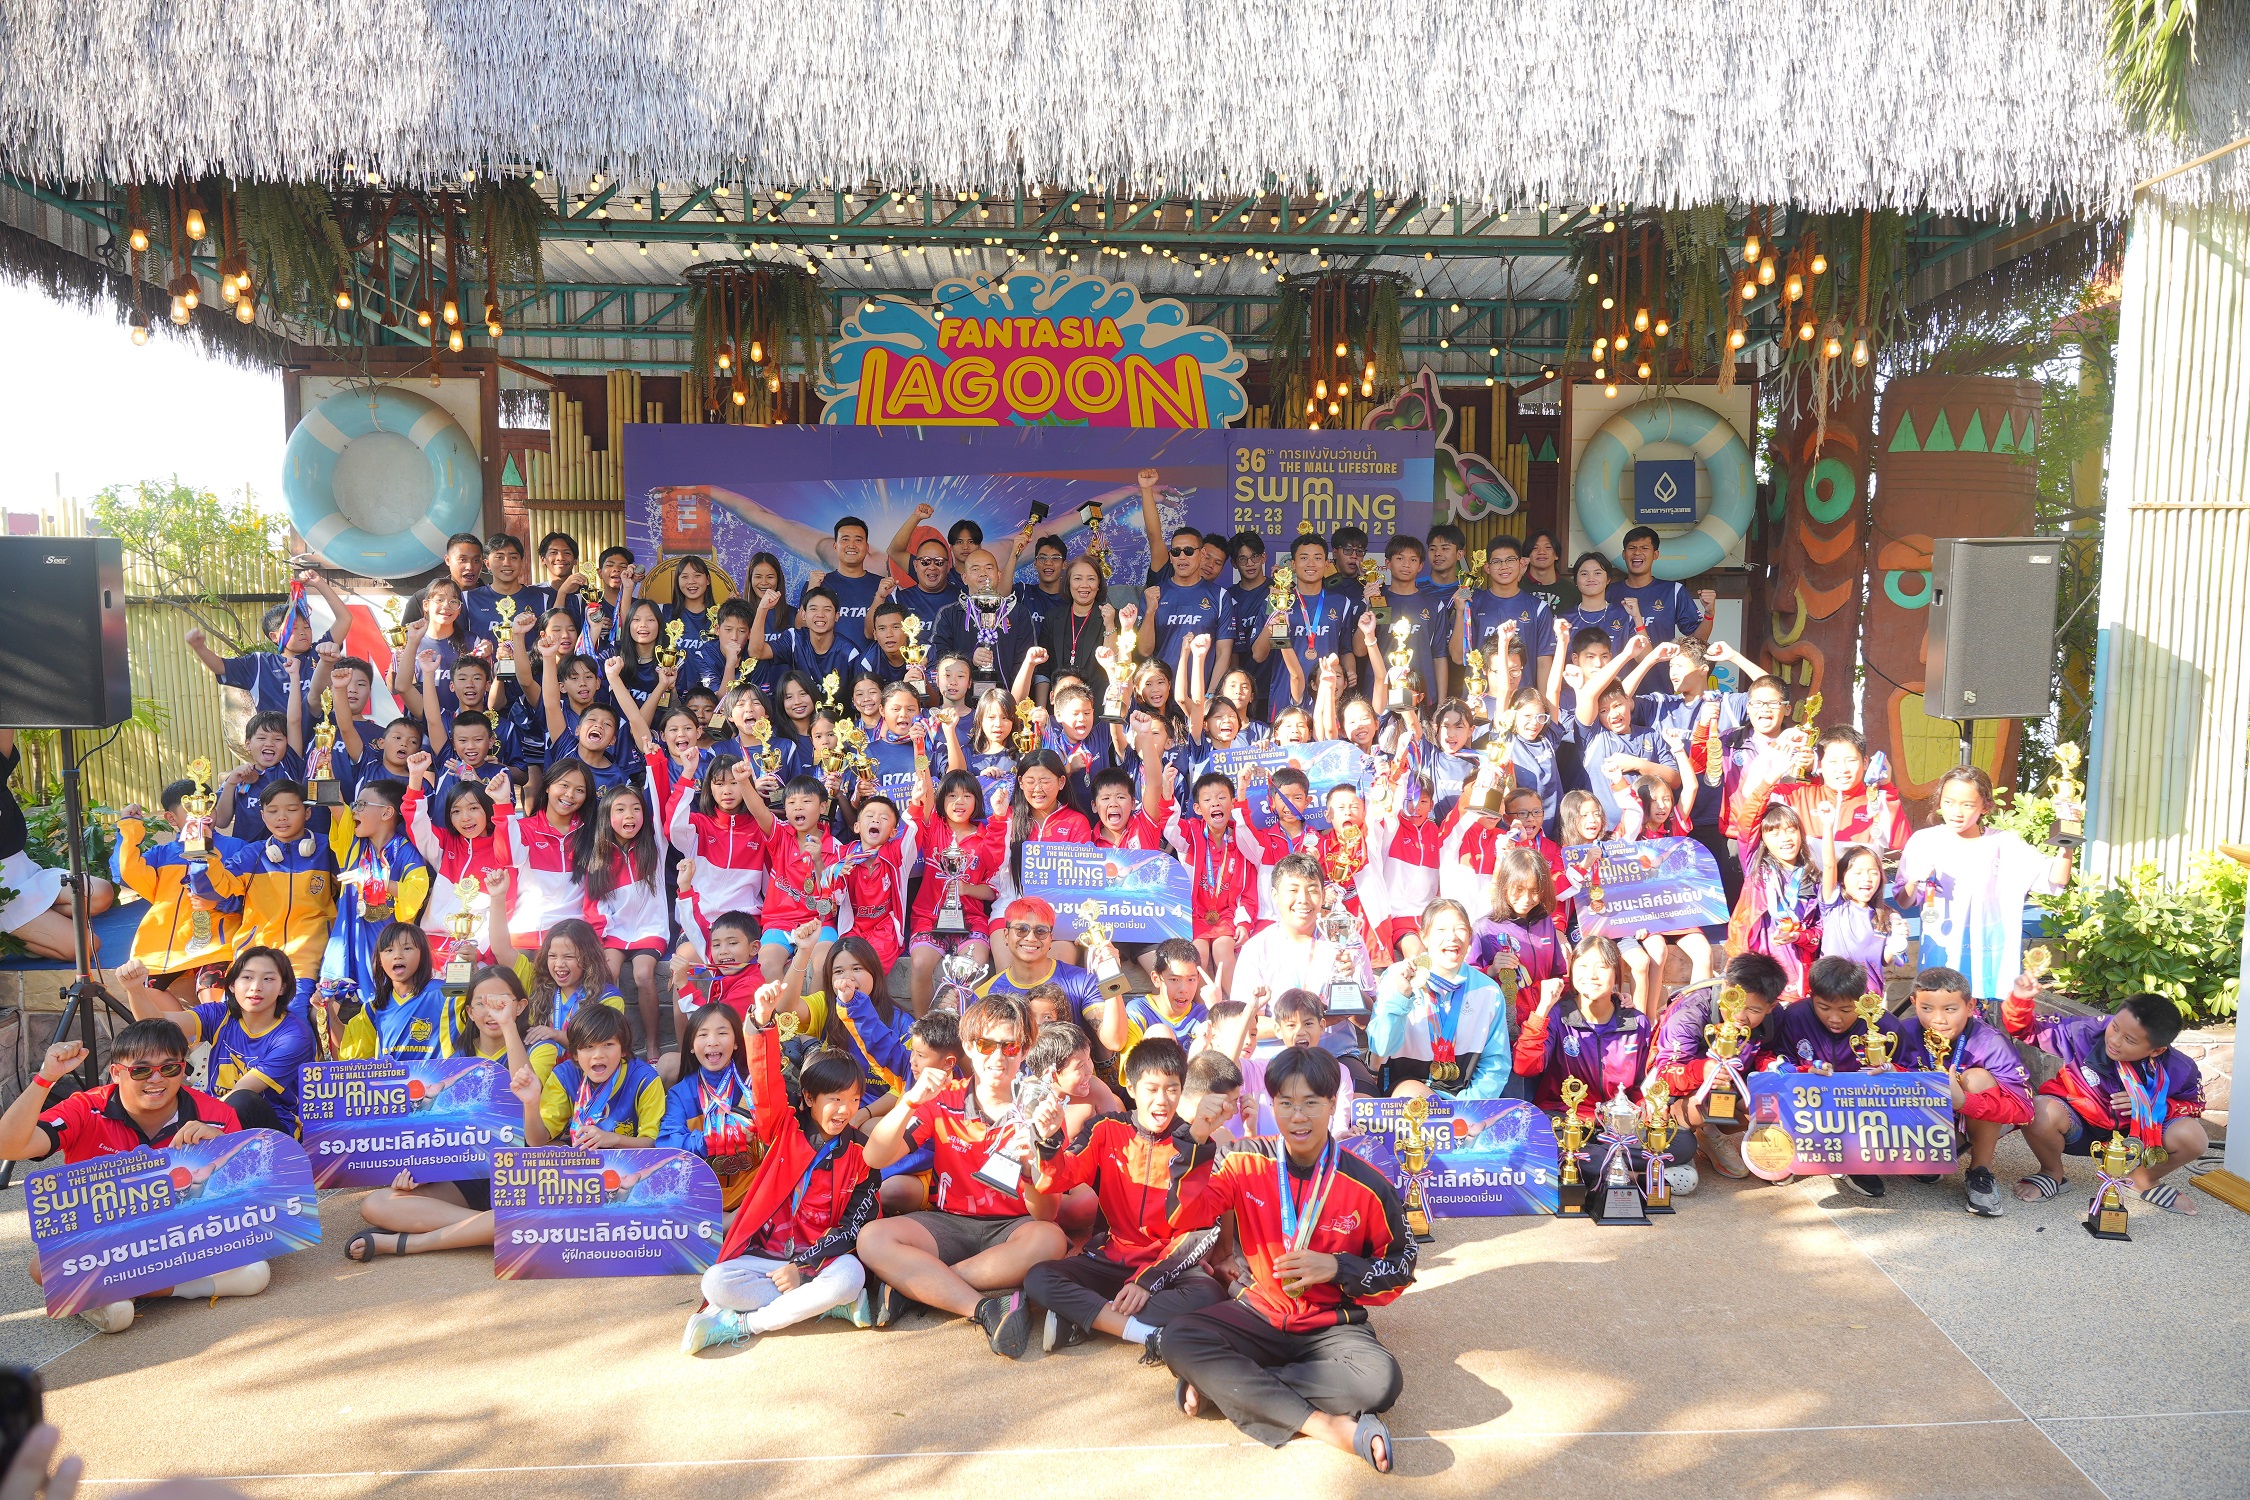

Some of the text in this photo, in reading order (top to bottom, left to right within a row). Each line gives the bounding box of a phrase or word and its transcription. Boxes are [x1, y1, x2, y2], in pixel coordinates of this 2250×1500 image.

[939, 316, 1123, 349] FANTASIA
[854, 346, 1209, 427] LAGOON
[1279, 444, 1377, 460] การแข่งขันว่ายน้ำ
[1279, 462, 1397, 474] THE MALL LIFESTORE
[677, 494, 697, 532] THE
[840, 606, 870, 617] RTA
[1167, 614, 1202, 626] RTAF
[1171, 904, 1183, 917] 4
[346, 1071, 366, 1080] MALL
[367, 1069, 406, 1078] LIFESTORE
[1833, 1081, 1926, 1096] การแข่งขันว่ายน้ำ
[1761, 1096, 1772, 1115] THE
[1833, 1096, 1947, 1108] THE MALL LIFESTORE
[319, 1125, 514, 1156] รองชนะเลิศอันดับ 6
[347, 1151, 486, 1170] คะแนนรวมสโมสรยอดเยี่ยม
[522, 1158, 600, 1167] THE MALL LIFESTORE
[1828, 1152, 1843, 1163] 68
[68, 1158, 165, 1187] THE MALL LIFESTORE
[1533, 1168, 1547, 1185] 3
[65, 1222, 78, 1233] 68
[511, 1219, 712, 1246] รองชนะเลิศอันดับ 6
[62, 1196, 303, 1277] รองชนะเลิศอันดับ 5
[103, 1229, 274, 1286] คะแนนรวมสโมสรยอดเยี่ยม
[561, 1245, 662, 1264] ผู้ฝึกสอนยอดเยี่ยม
